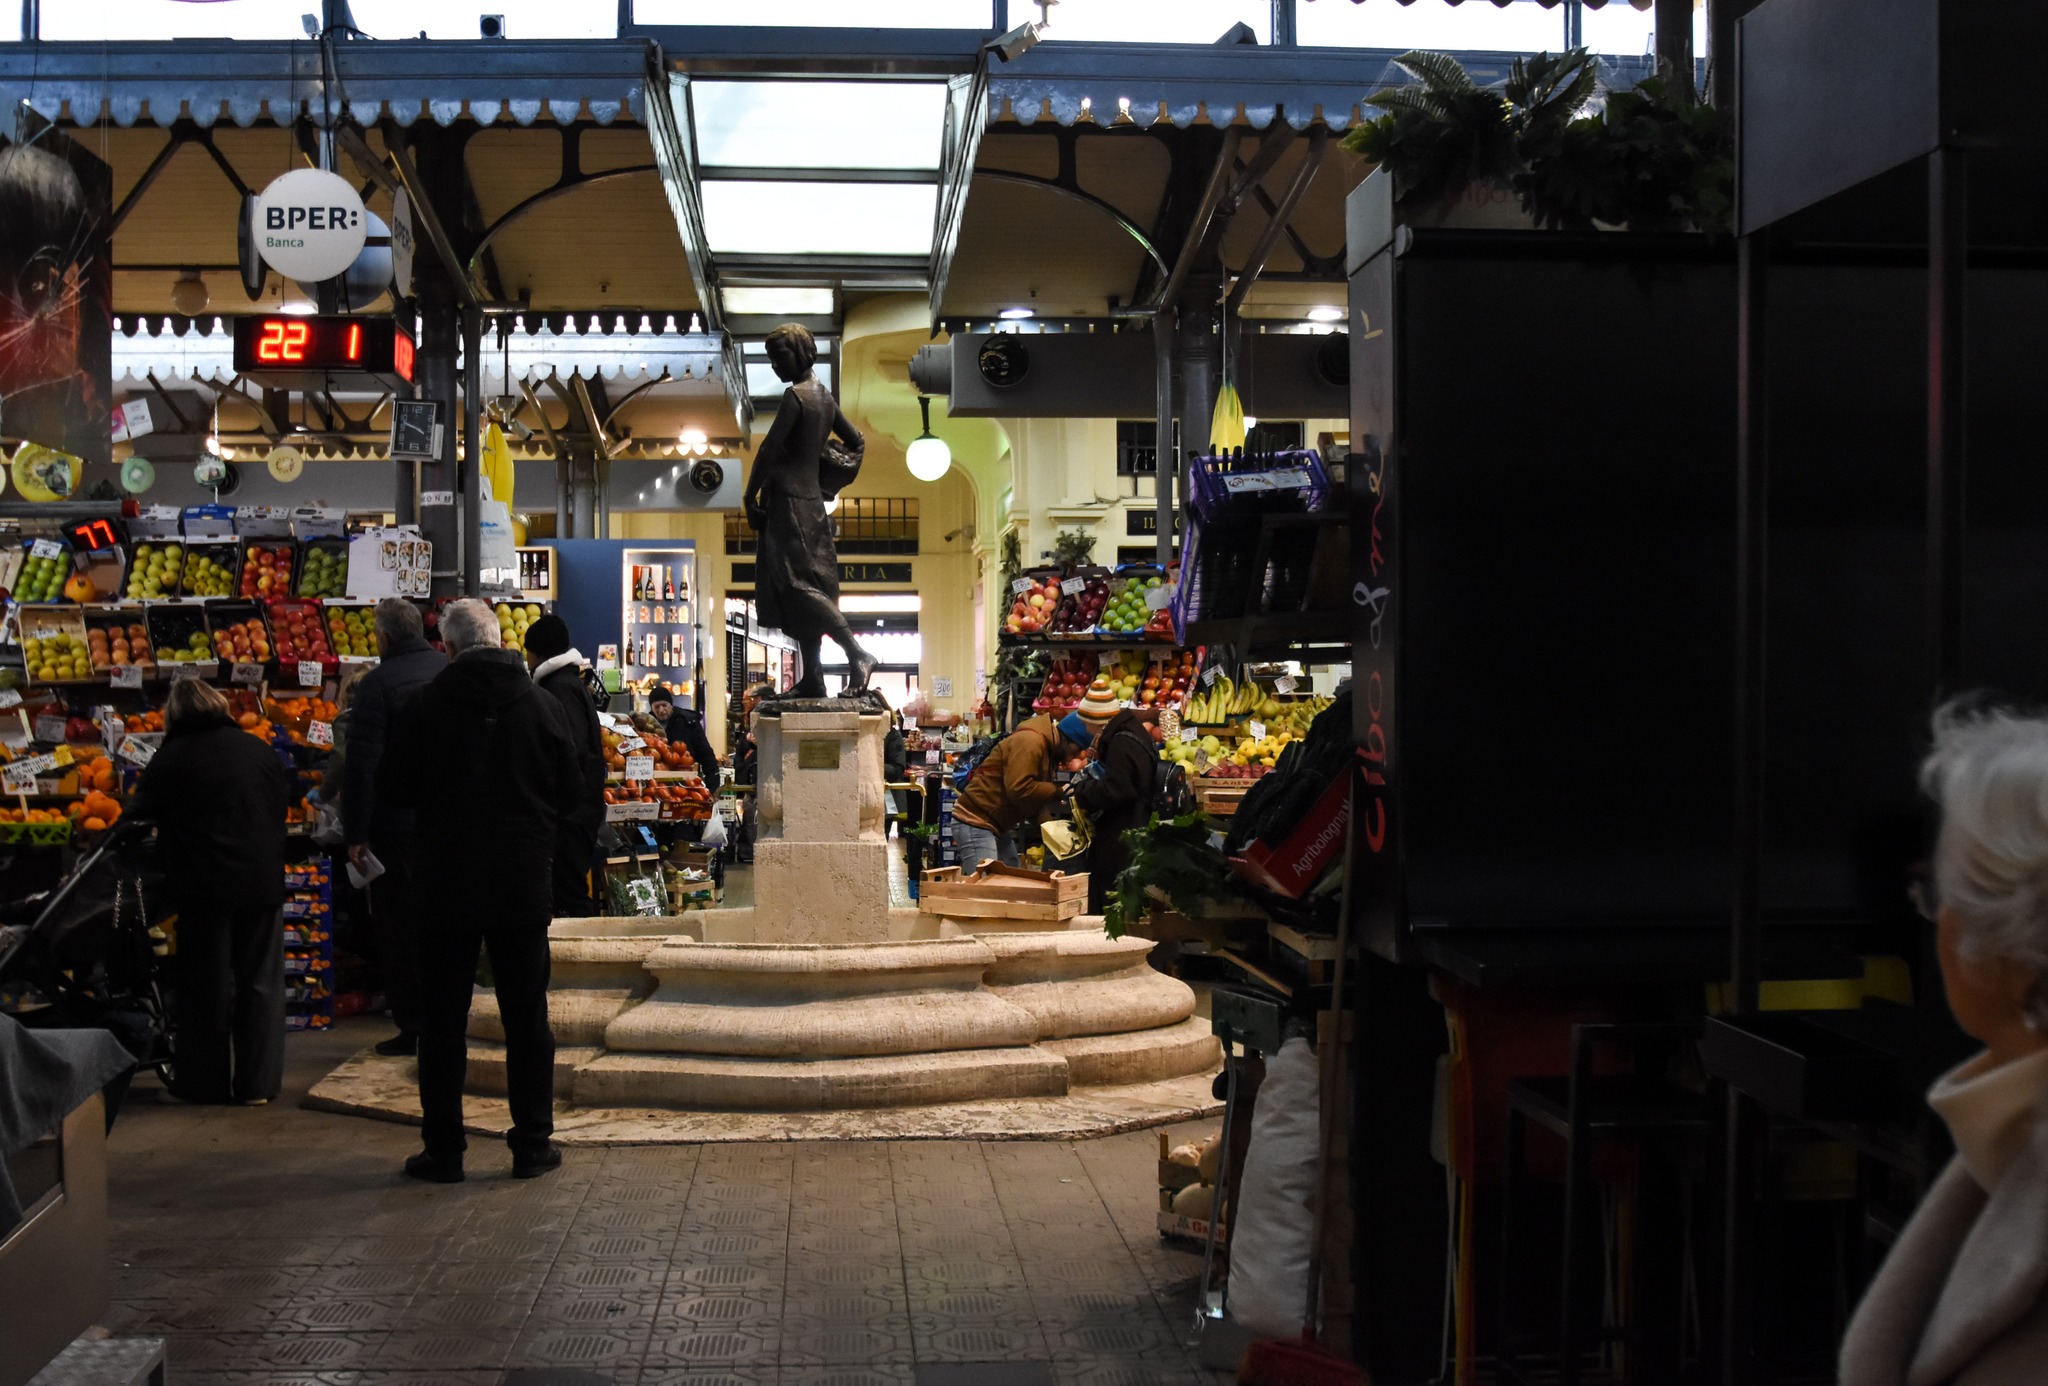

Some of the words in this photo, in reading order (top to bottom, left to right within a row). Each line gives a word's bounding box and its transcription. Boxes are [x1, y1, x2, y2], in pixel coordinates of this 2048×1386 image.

[266, 207, 358, 230] BPER:
[266, 236, 304, 248] Banca
[259, 322, 307, 360] 22
[348, 323, 361, 360] 1
[75, 519, 116, 550] 77
[1143, 516, 1156, 530] IL
[843, 565, 888, 580] RIA
[1352, 580, 1391, 650] &
[1291, 810, 1349, 878] Agribologna
